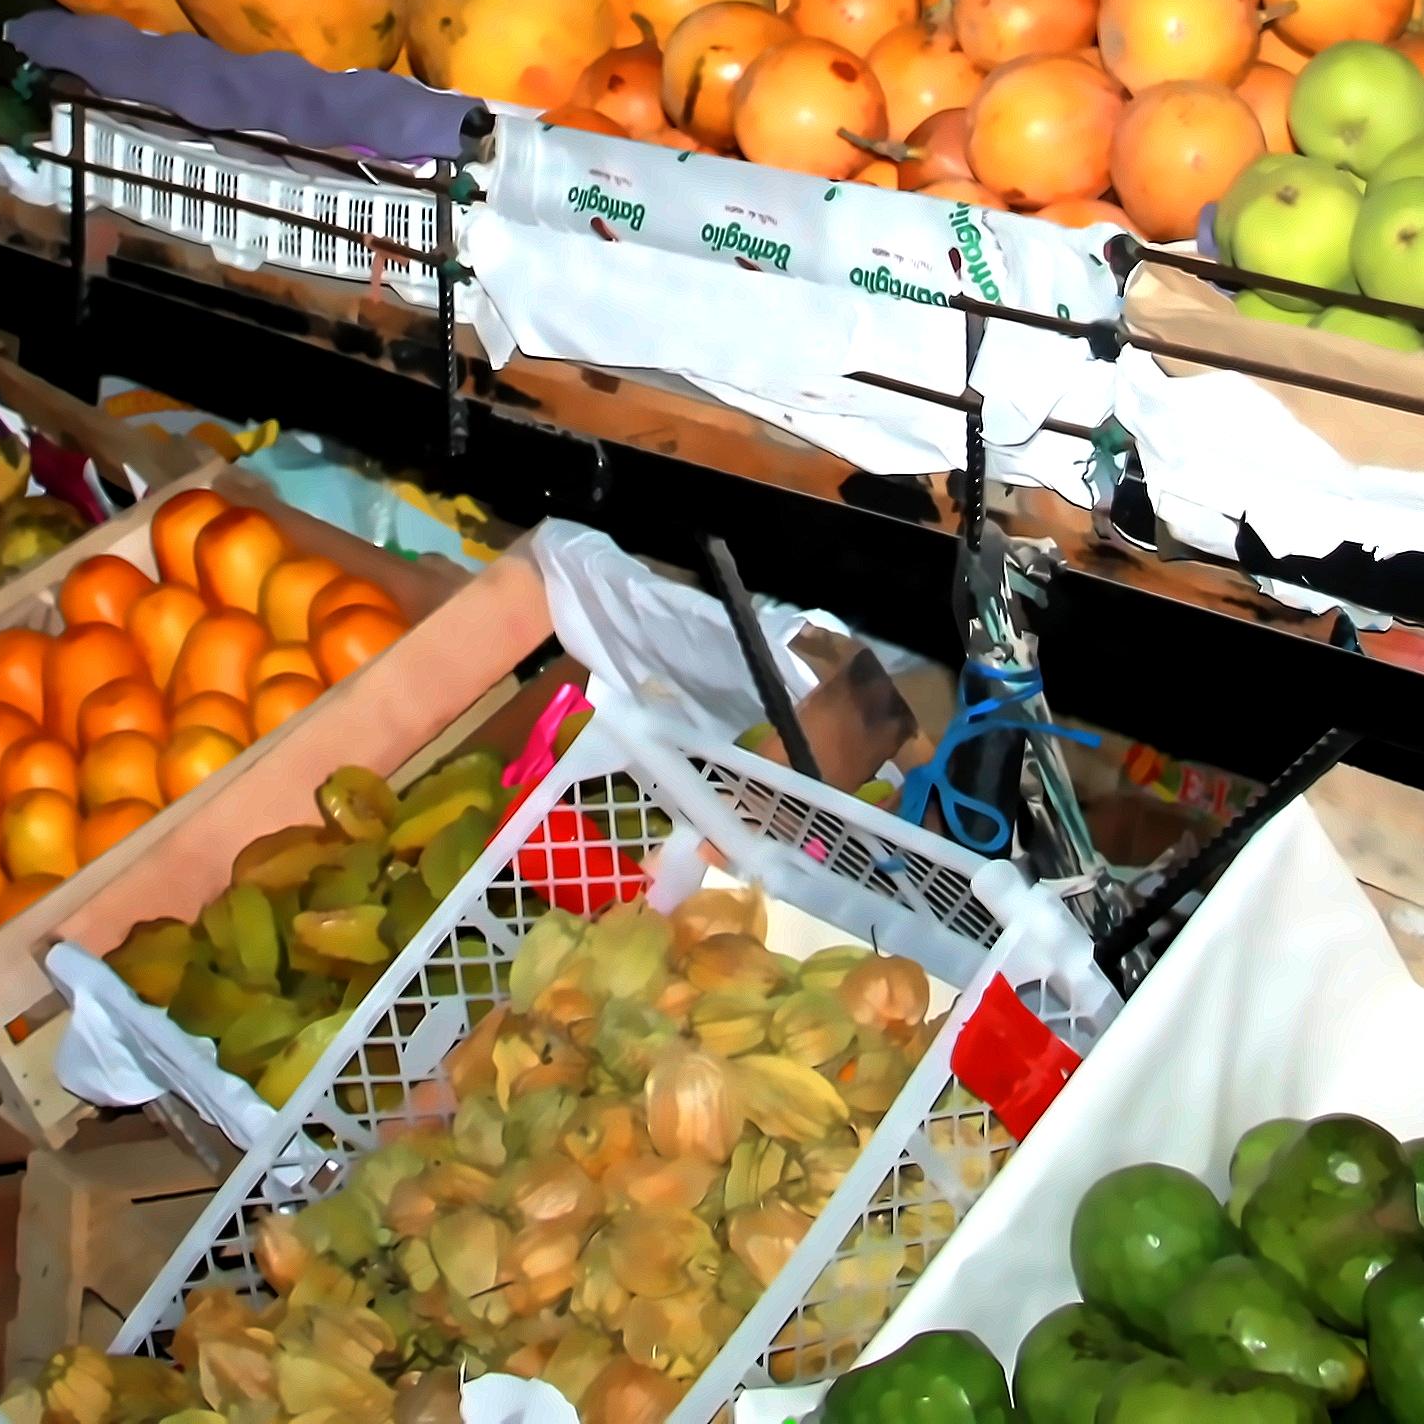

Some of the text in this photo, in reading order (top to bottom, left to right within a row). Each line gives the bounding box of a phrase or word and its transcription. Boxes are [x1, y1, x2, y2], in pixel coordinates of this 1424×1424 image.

[567, 184, 646, 232] Battaglio
[701, 222, 792, 272] Battaglio
[947, 201, 1004, 306] attagli
